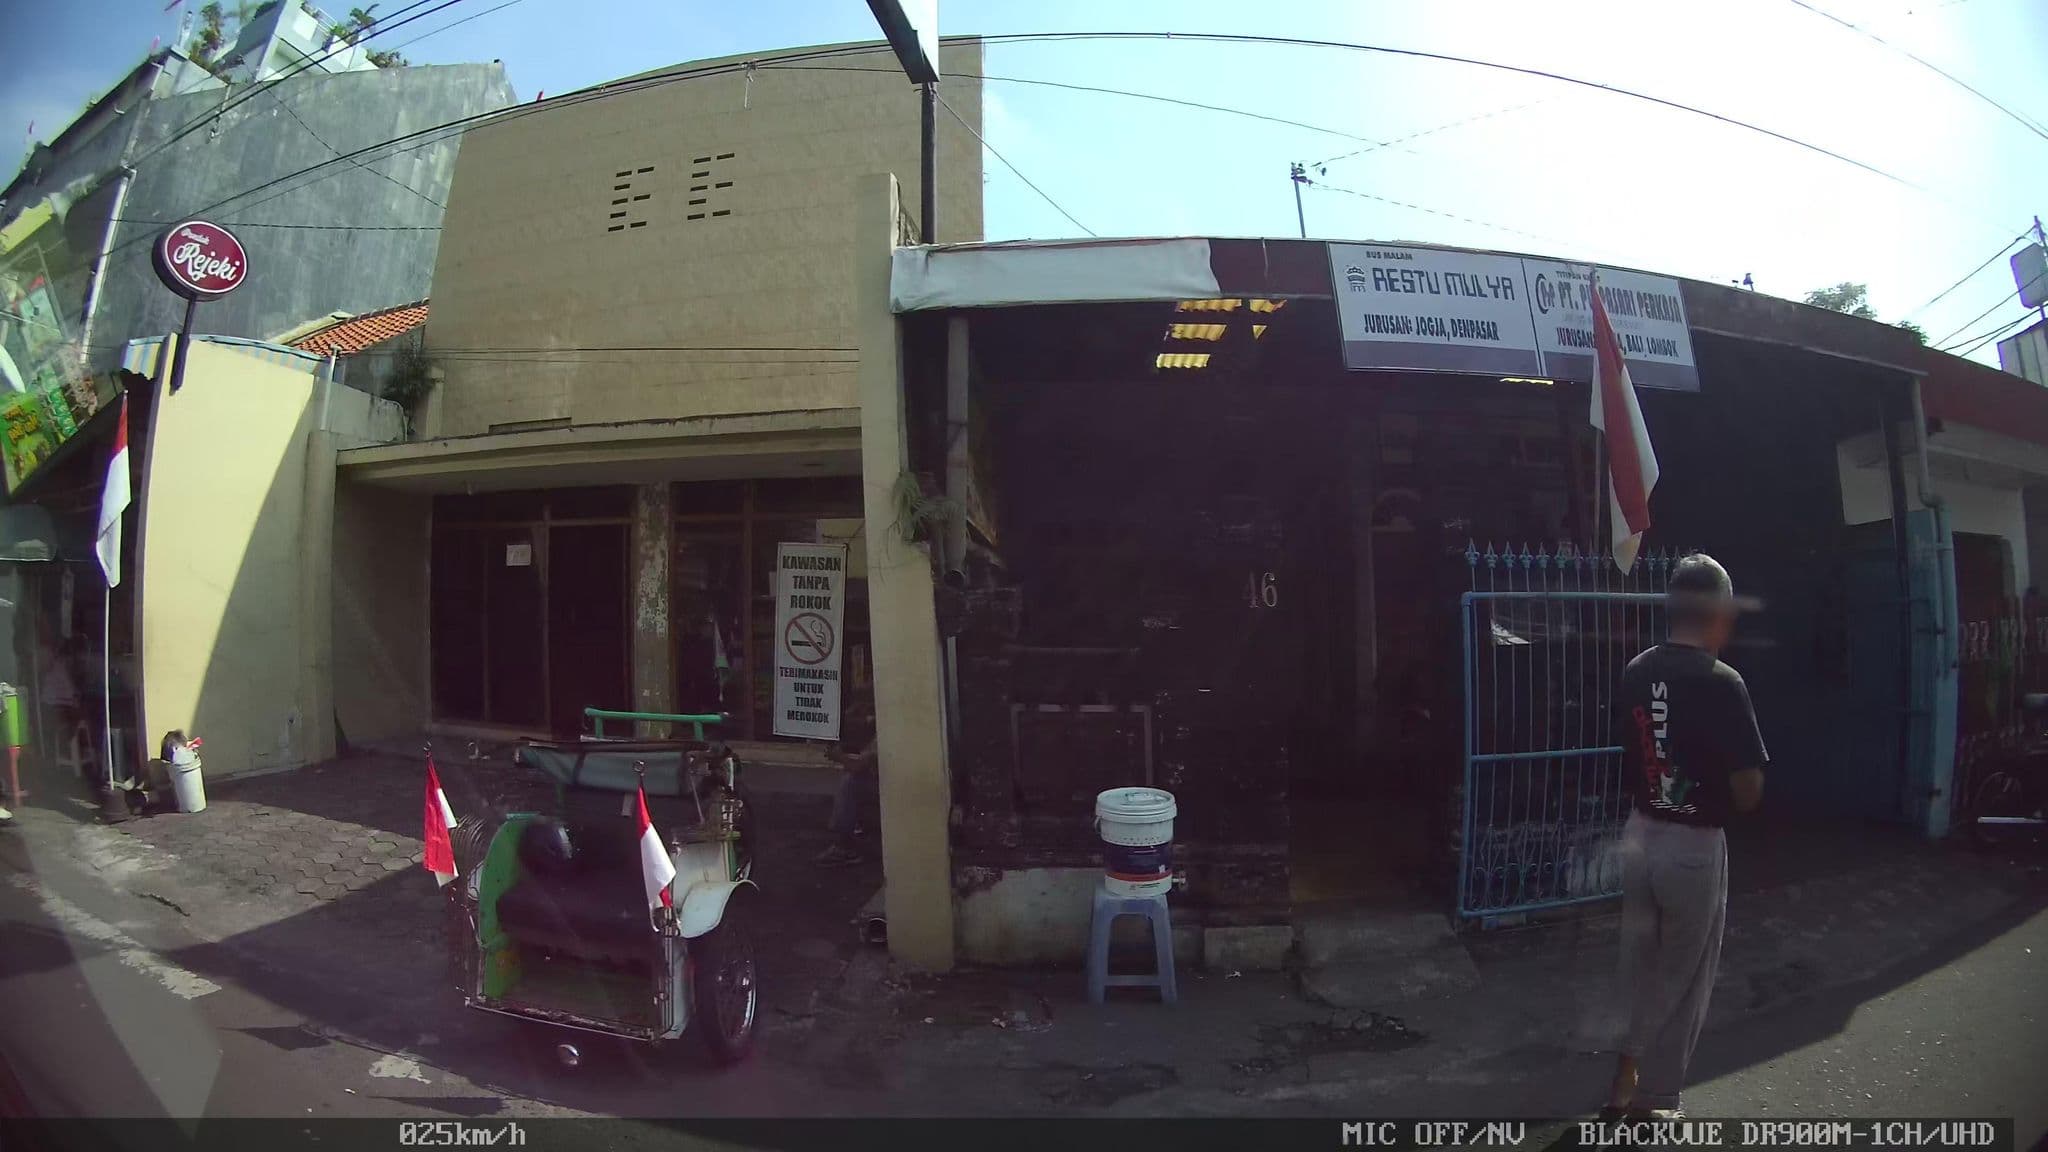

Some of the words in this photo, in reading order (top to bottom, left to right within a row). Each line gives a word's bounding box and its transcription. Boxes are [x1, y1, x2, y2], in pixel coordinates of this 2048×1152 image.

[173, 242, 240, 281] Rejeki
[1366, 251, 1382, 259] BUS
[1383, 252, 1413, 260] MALAM
[1372, 267, 1440, 294] RESTU
[1444, 272, 1515, 300] MULYA
[1558, 280, 1579, 310] PT.
[1636, 290, 1683, 324] PERKASA
[1364, 314, 1413, 335] JURUSAN:
[1415, 316, 1450, 341] JOGJA,
[1450, 319, 1500, 341] DENPASAR
[1646, 336, 1680, 358] LOMBOK
[782, 555, 841, 571] KAWASAN
[792, 575, 831, 591] TANPA
[790, 595, 832, 610] ROKOK
[780, 666, 838, 681] TERIMAKASIH
[793, 682, 824, 695] UNTUK
[795, 696, 823, 709] TIDAK
[787, 710, 830, 724] MEROKOK
[1651, 681, 1669, 760] PLUS
